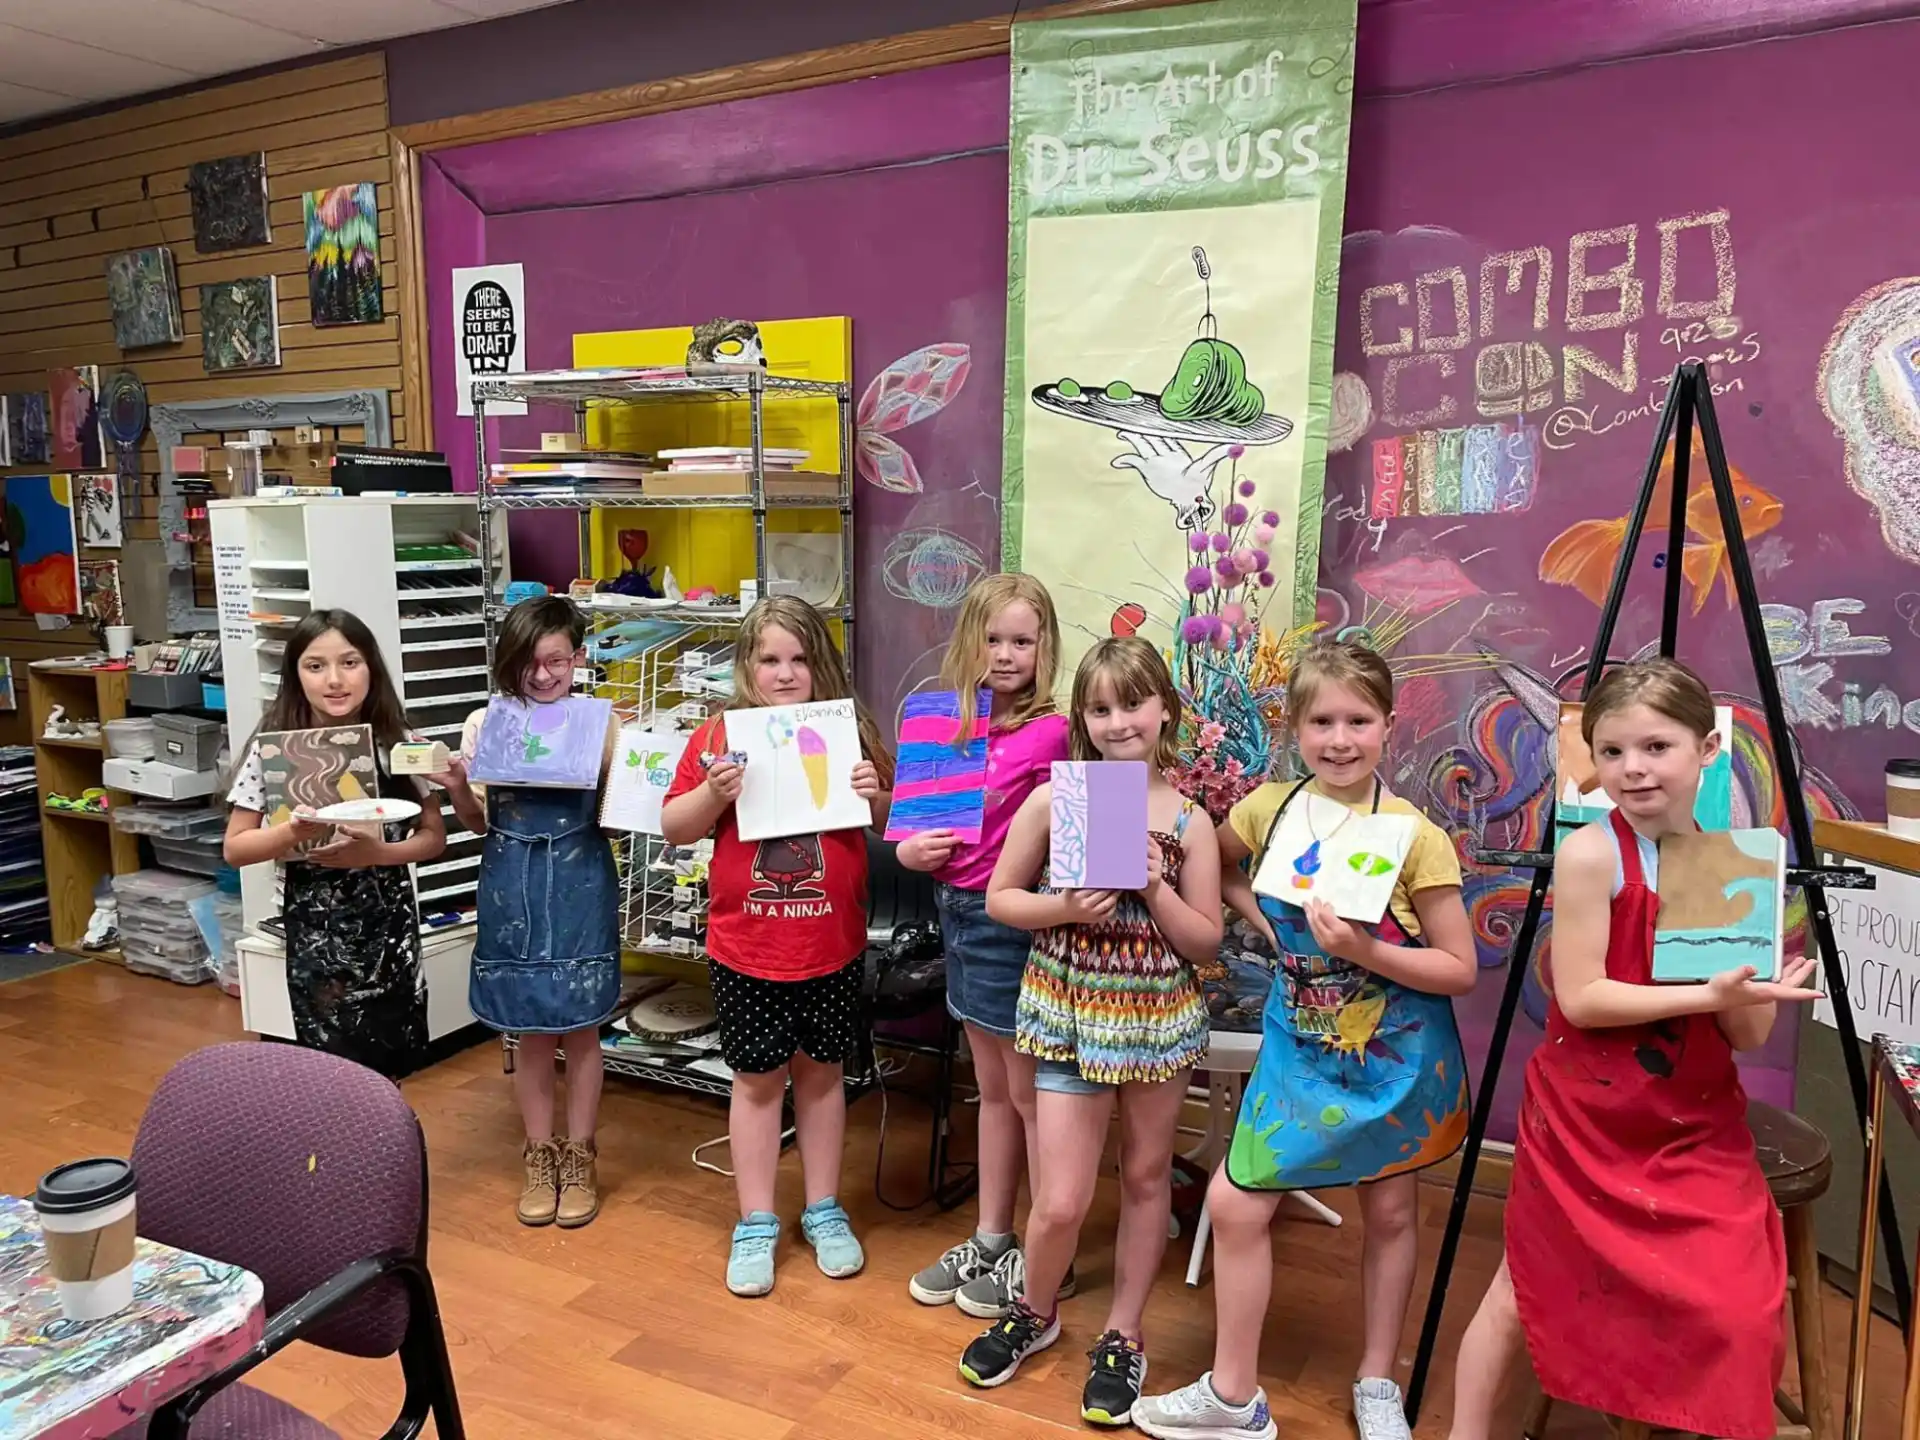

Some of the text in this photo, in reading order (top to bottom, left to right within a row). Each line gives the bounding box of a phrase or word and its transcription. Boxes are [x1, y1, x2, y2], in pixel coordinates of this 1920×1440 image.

[1068, 50, 1285, 117] The Art of
[1027, 120, 1321, 195] Dr. Seuss
[1359, 206, 1737, 358] COMBO
[473, 286, 503, 308] THERE
[466, 307, 511, 321] SEEMS
[466, 320, 512, 334] TO BE A
[466, 333, 512, 356] DRAFT
[473, 356, 505, 369] IN
[1758, 597, 1892, 666] BE
[742, 899, 834, 919] I'M A NINJA
[1827, 894, 1852, 934] BE
